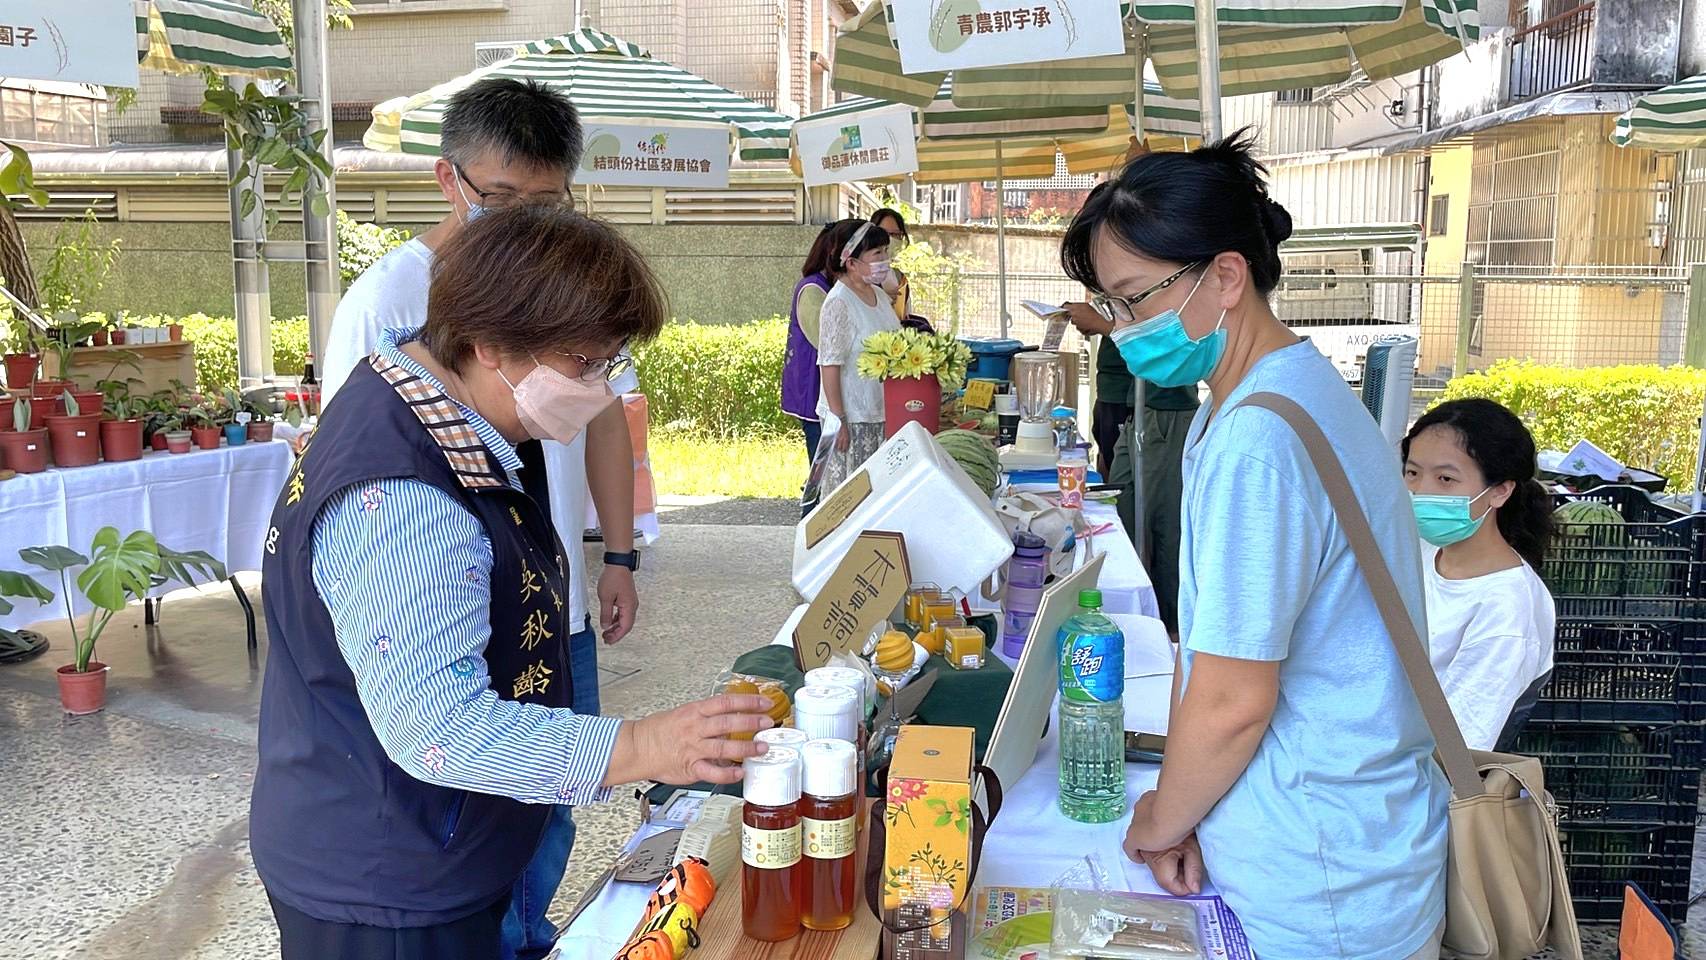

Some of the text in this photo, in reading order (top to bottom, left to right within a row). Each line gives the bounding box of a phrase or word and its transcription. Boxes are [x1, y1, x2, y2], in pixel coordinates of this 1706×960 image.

[957, 6, 1051, 36] 青農郭宇承
[593, 155, 711, 173] 結頭份社區發展協會
[512, 558, 554, 699] 吳秋齡
[1071, 644, 1104, 676] 舒跑
